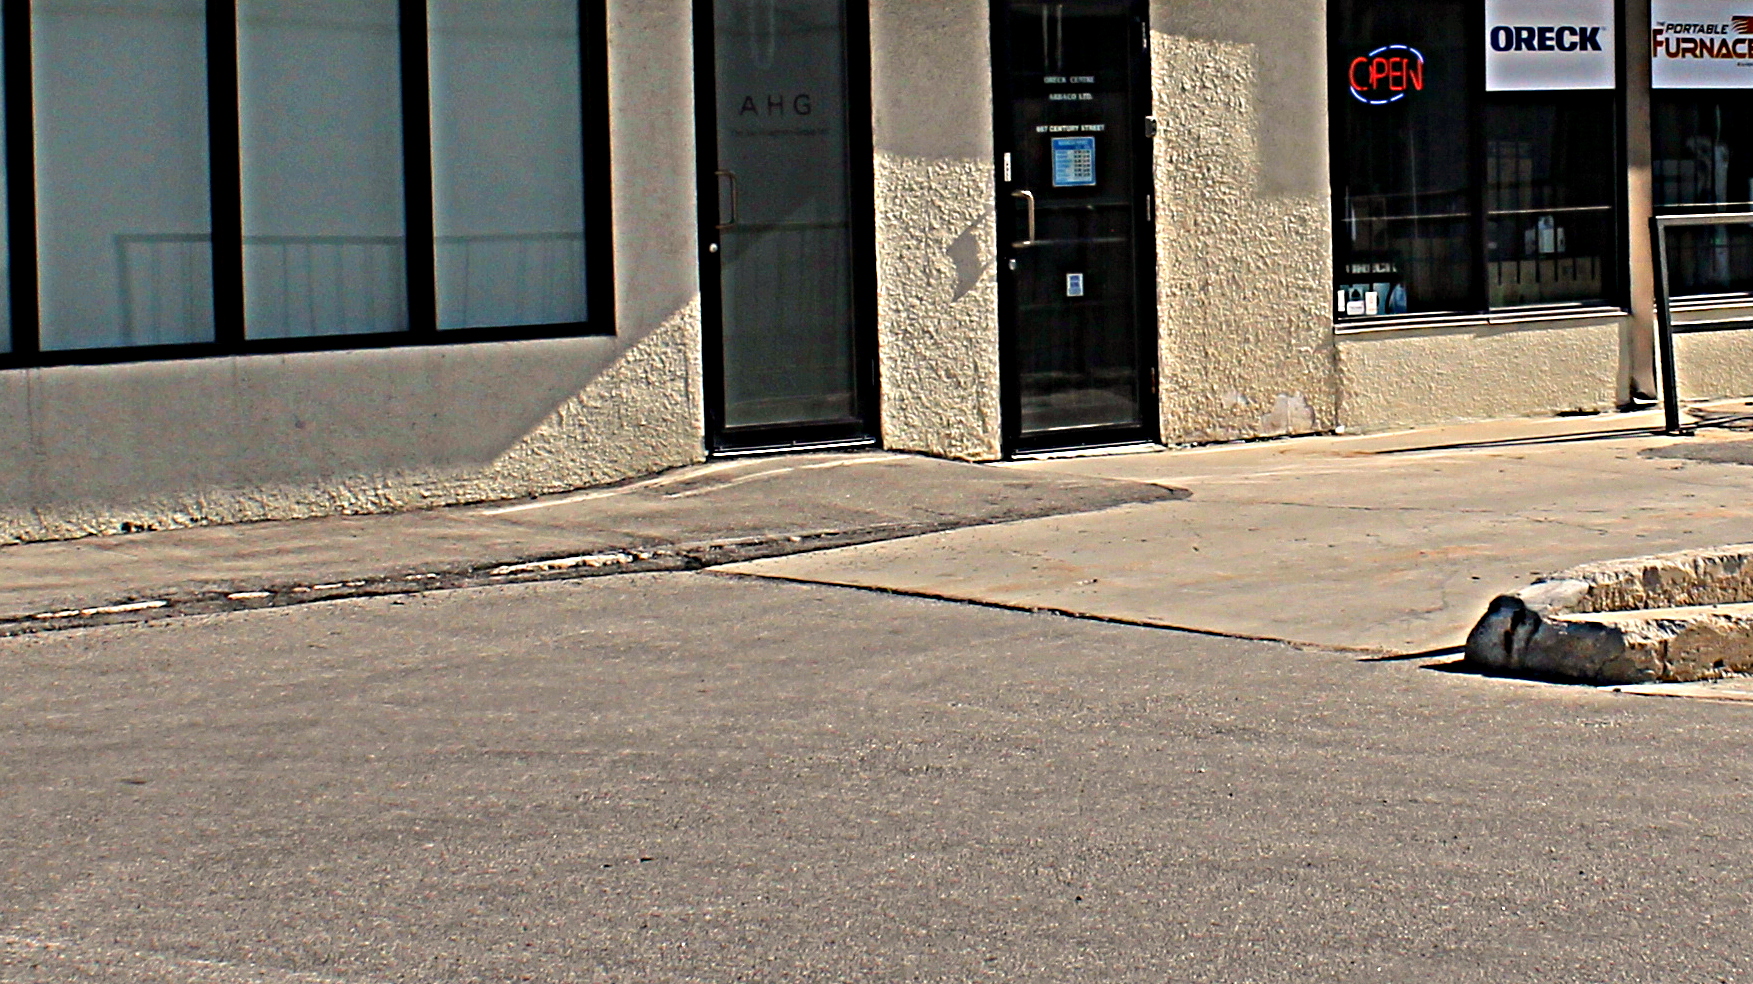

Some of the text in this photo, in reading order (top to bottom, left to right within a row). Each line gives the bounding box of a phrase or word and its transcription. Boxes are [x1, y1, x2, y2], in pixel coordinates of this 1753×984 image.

[1490, 25, 1602, 52] ORECK
[1665, 23, 1729, 34] PORTABLE
[1348, 56, 1424, 91] OPEN
[739, 94, 812, 116] AHG
